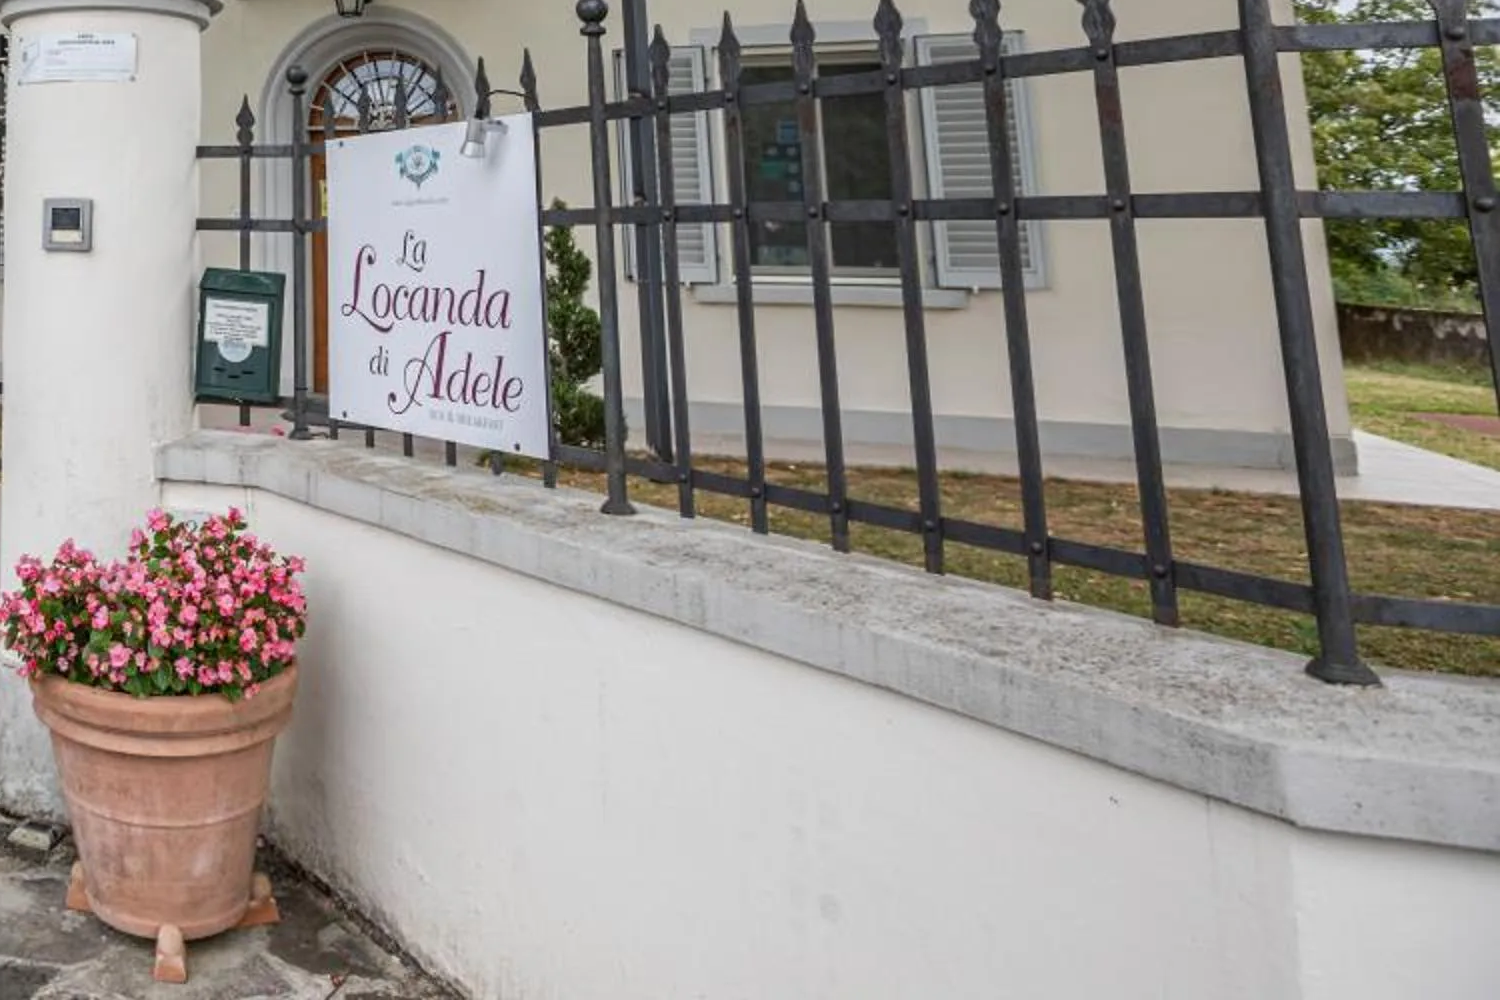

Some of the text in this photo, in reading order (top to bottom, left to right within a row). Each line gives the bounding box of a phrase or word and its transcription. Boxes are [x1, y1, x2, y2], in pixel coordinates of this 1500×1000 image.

[341, 244, 511, 334] Locanda
[396, 229, 428, 273] La
[368, 330, 524, 415] di Adele
